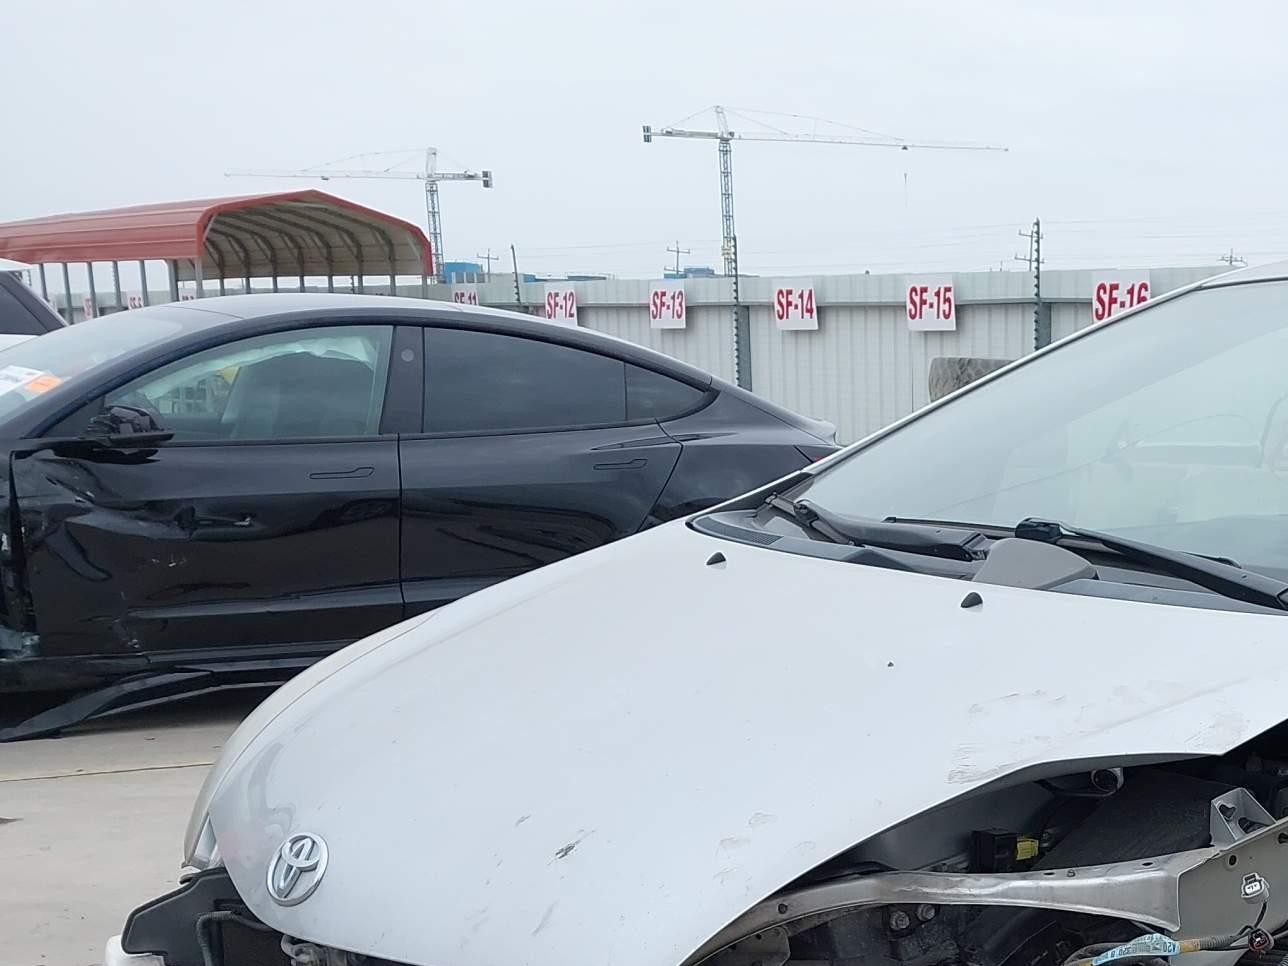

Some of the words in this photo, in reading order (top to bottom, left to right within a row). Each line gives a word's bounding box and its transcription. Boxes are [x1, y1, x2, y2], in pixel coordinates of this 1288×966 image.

[546, 291, 576, 319] SF-12
[651, 290, 684, 319] SF-13
[776, 288, 814, 321] SF-14
[908, 286, 952, 321] SF-15
